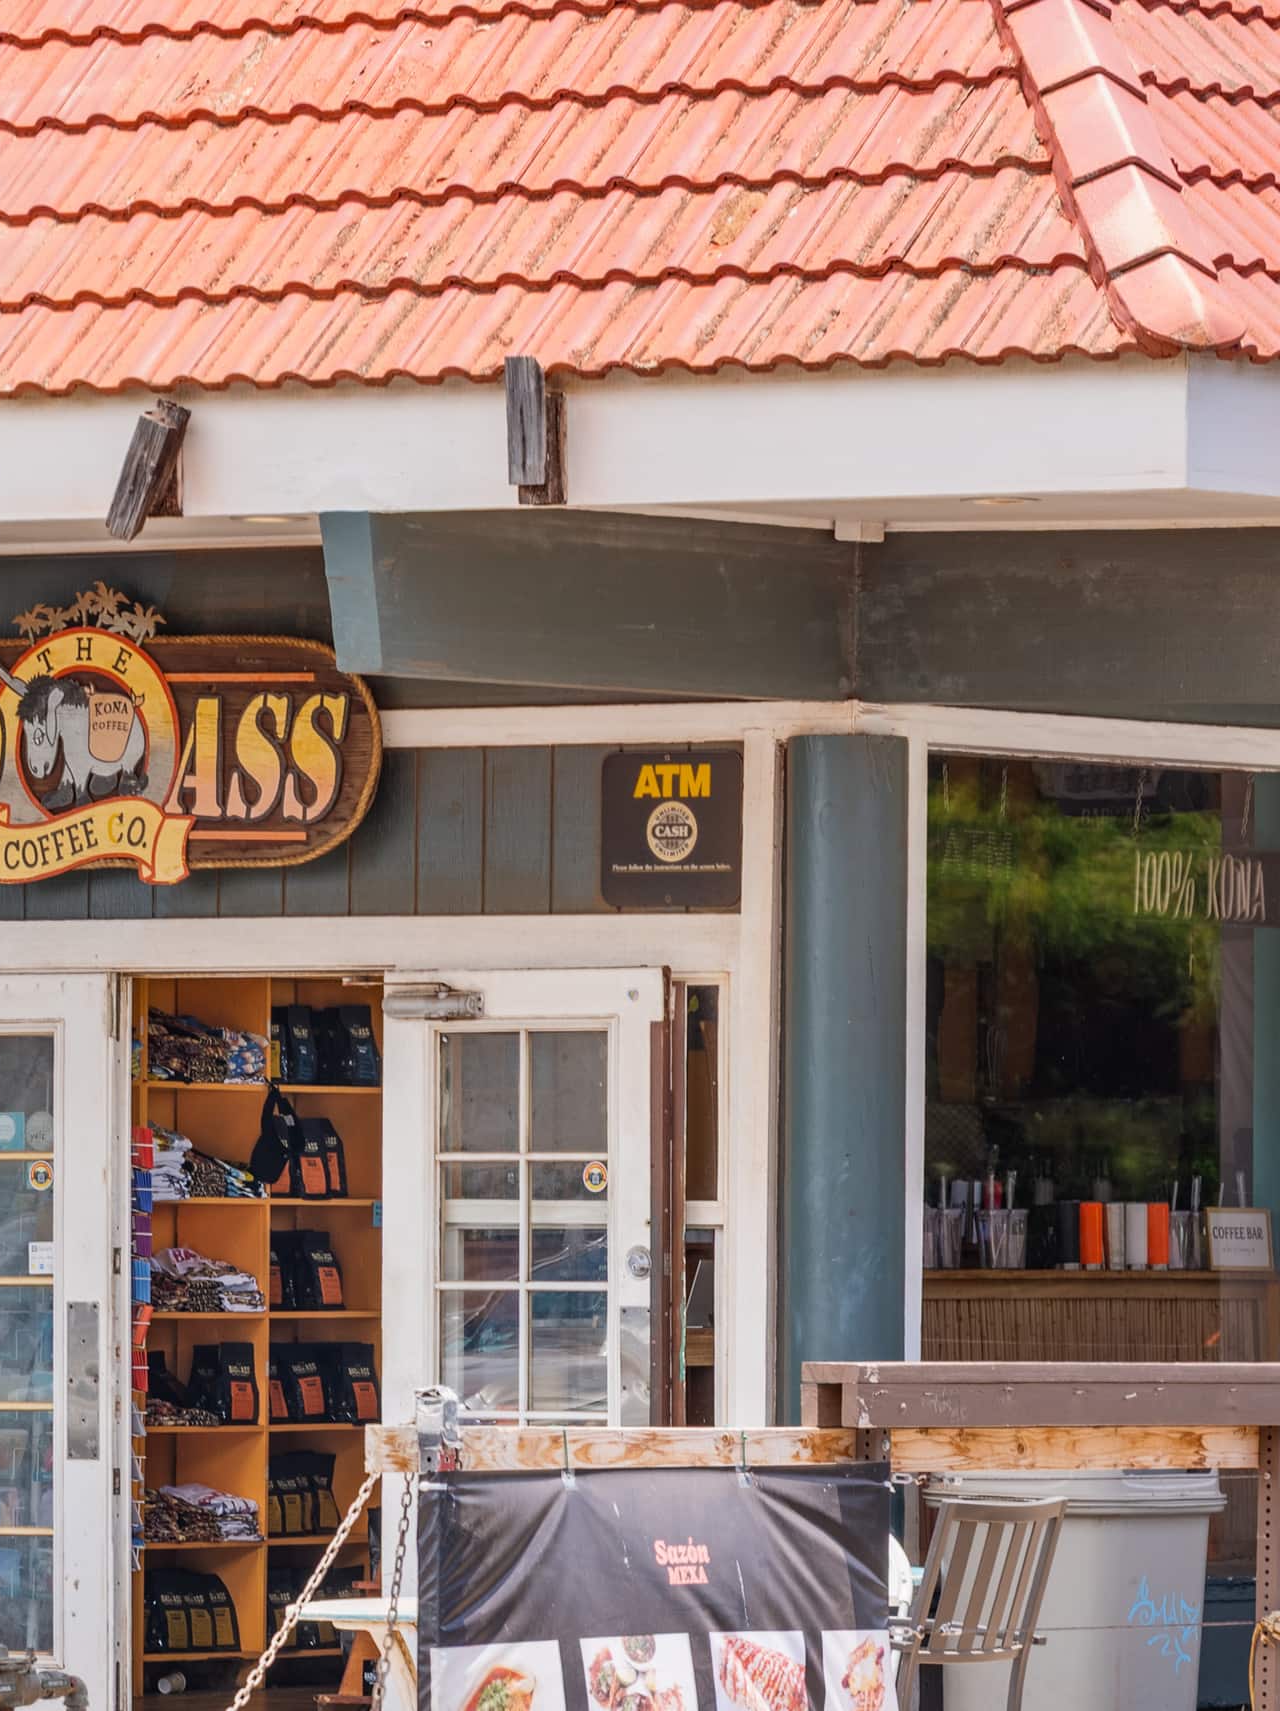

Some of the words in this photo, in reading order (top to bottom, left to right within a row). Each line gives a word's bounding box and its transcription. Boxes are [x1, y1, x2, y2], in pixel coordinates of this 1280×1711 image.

[37, 638, 132, 675] THE
[94, 700, 130, 716] KONA
[92, 720, 130, 732] COFFEE
[163, 693, 348, 820] ASS
[633, 763, 711, 799] ATM
[4, 817, 99, 870] COFFEE
[107, 812, 148, 848] CO.
[654, 825, 689, 838] CASH
[1134, 850, 1195, 920] 100%
[1206, 853, 1266, 921] KONA
[1212, 1226, 1246, 1240] COFFEE
[1247, 1226, 1265, 1240] BAR
[654, 1536, 711, 1566] Sazón
[667, 1565, 709, 1585] MEXA
